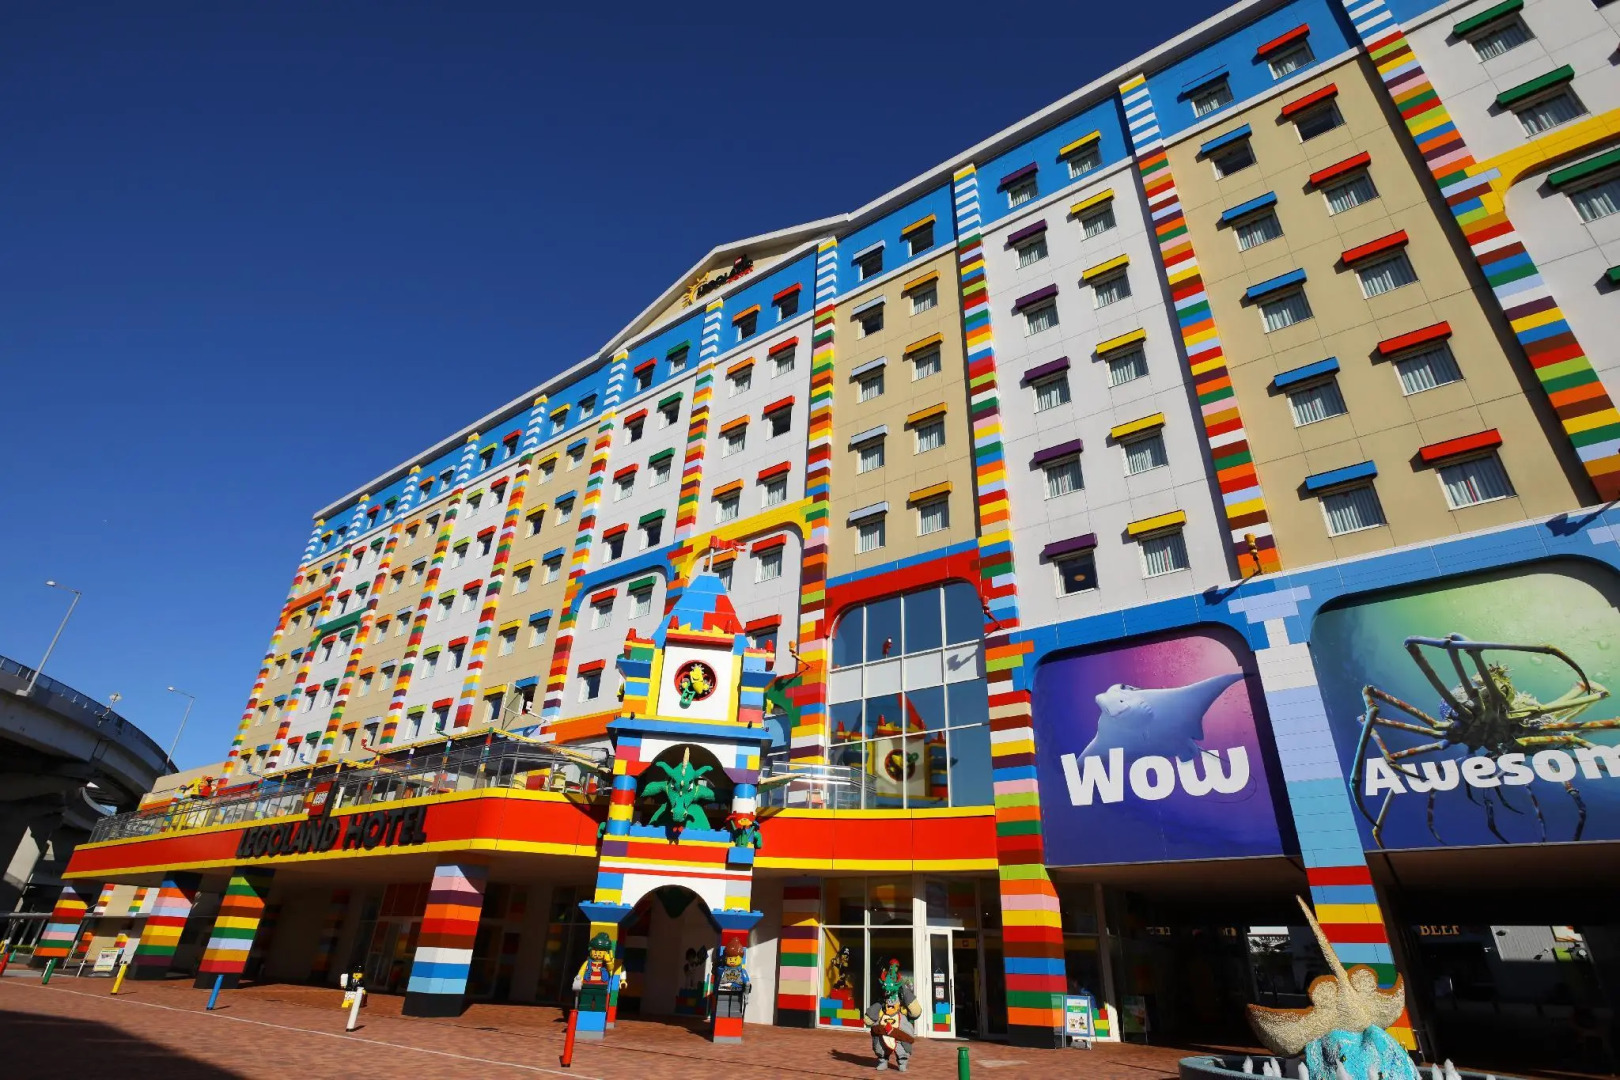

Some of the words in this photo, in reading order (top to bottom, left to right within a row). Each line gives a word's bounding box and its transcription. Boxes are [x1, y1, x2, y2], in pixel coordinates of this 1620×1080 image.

[1060, 745, 1250, 806] Wow
[236, 816, 339, 858] LEGOLAND
[344, 806, 427, 850] HOTEL
